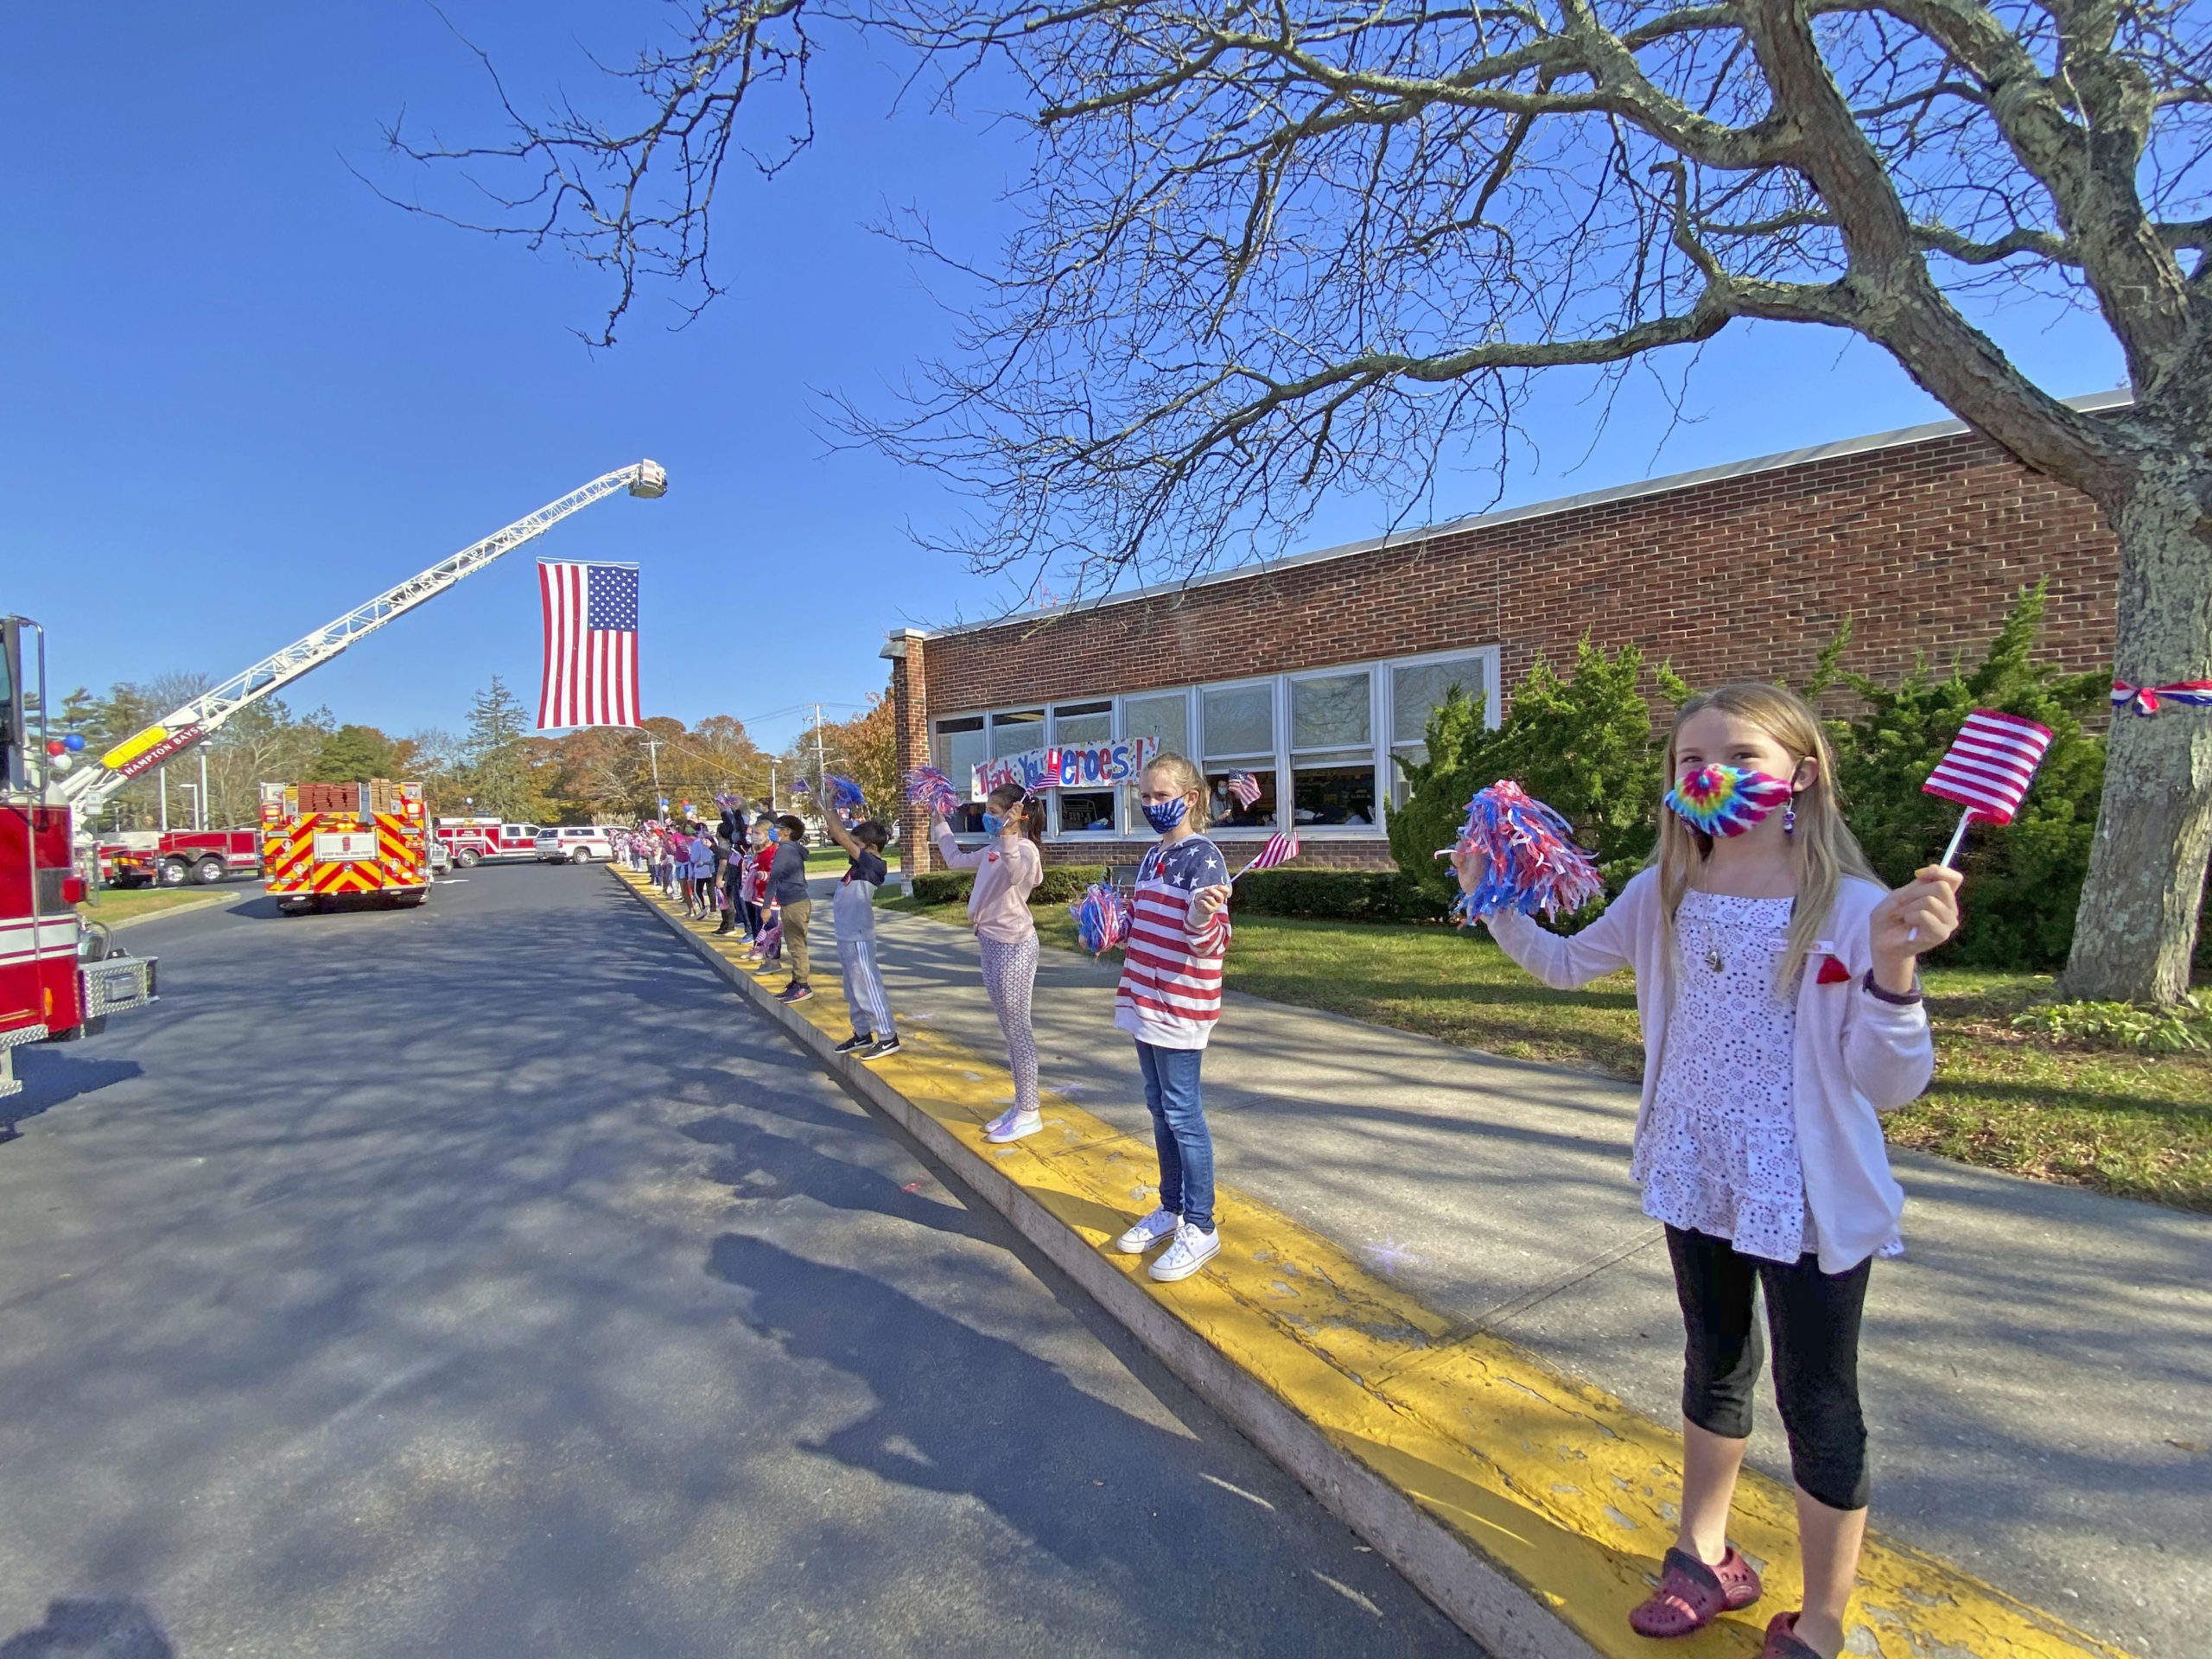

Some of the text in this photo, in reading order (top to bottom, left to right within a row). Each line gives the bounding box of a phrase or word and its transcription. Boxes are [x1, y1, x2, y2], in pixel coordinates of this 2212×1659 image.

[124, 727, 199, 775] HAMPTON BAYS
[976, 760, 1016, 797] Thank
